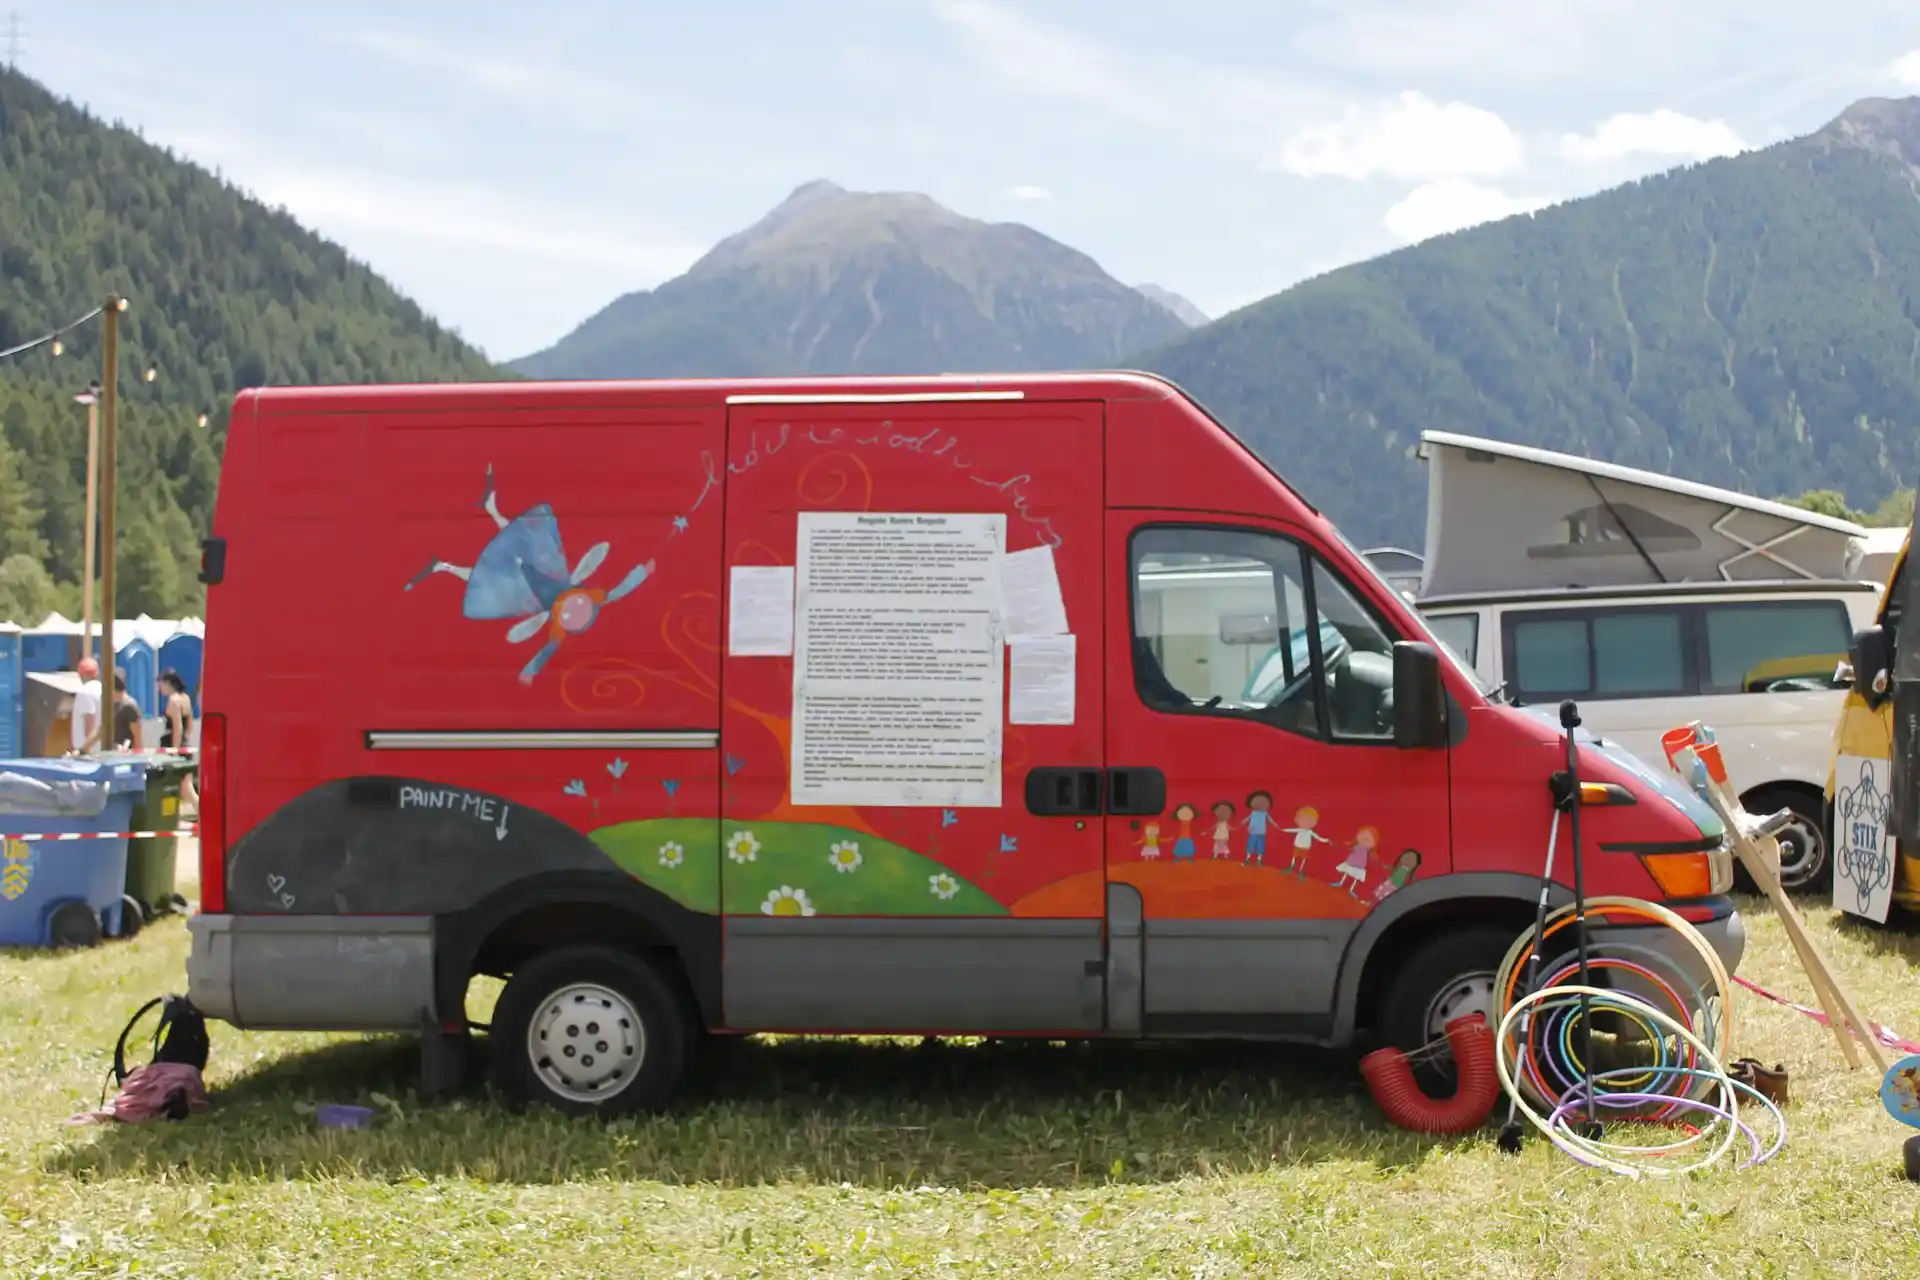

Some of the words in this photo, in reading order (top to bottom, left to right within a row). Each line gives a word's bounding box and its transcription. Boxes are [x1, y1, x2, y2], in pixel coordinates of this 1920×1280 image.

[400, 786, 460, 809] PAINT
[461, 793, 497, 821] ME
[1852, 822, 1878, 850] STIX
